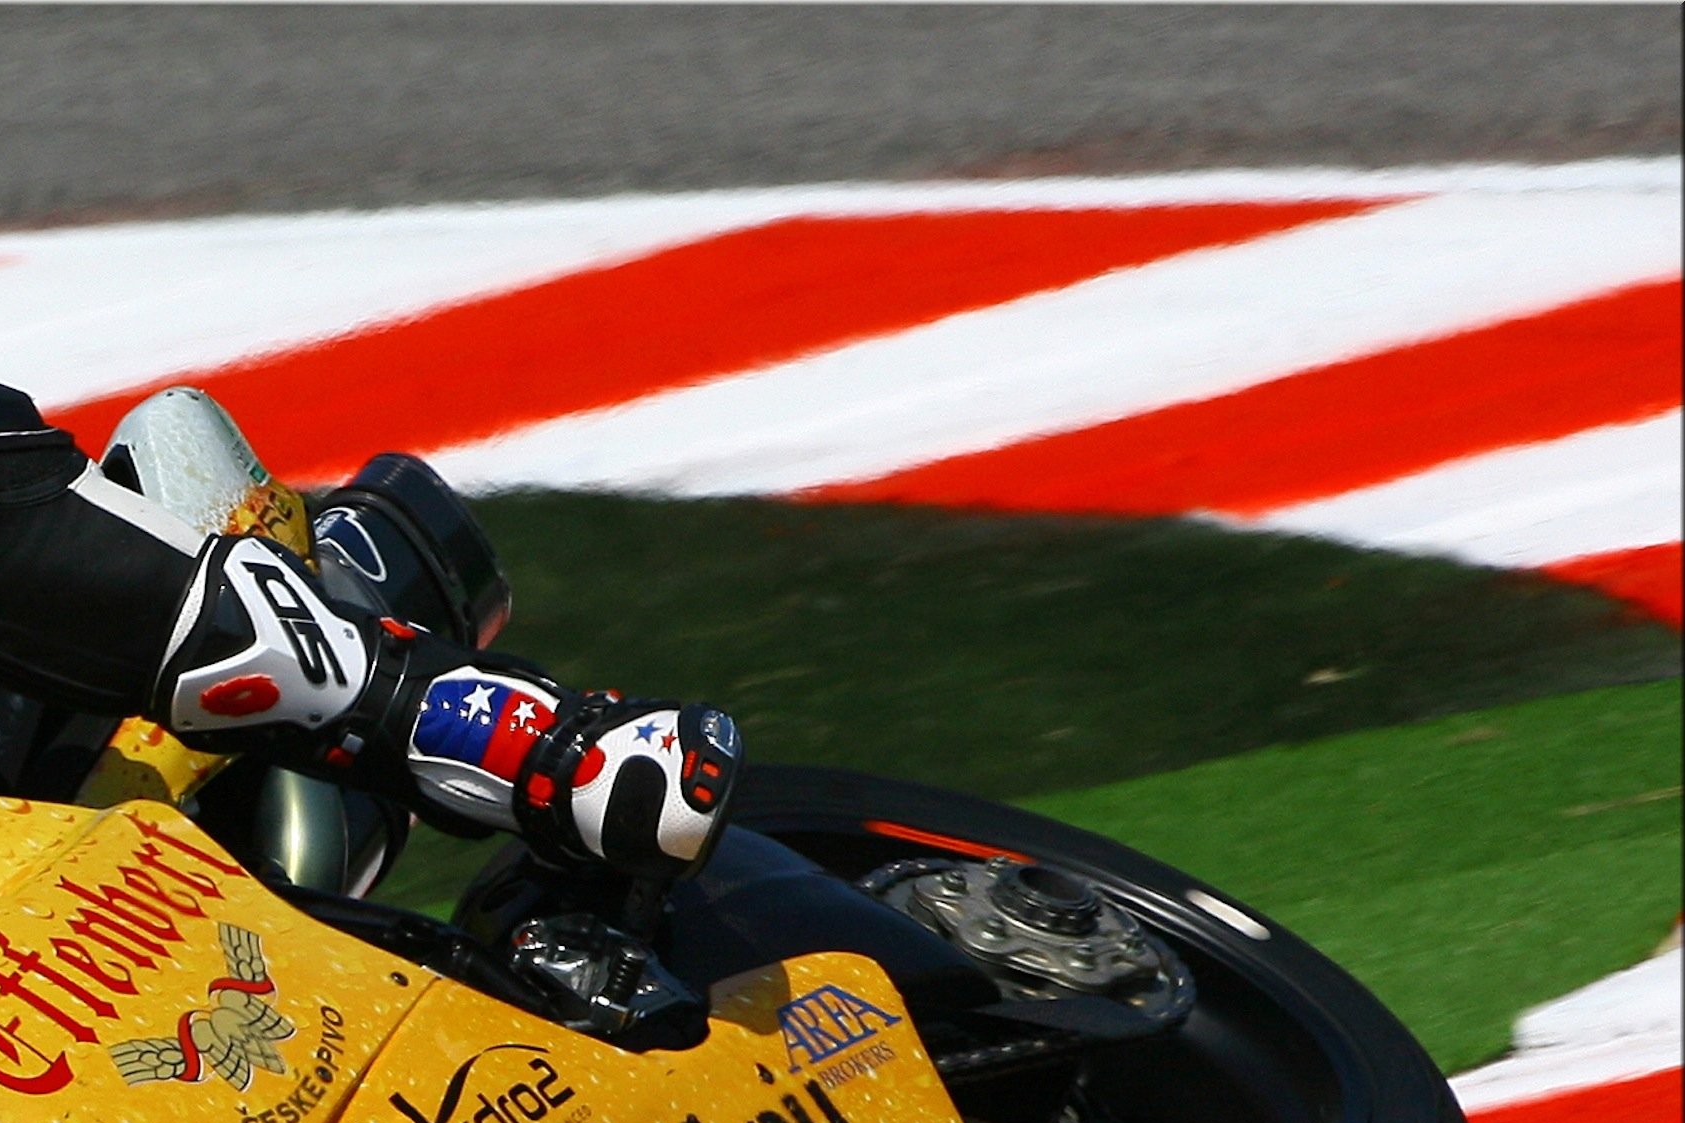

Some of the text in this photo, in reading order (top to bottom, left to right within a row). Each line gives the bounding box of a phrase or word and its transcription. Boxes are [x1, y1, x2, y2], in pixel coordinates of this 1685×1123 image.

[316, 1005, 345, 1069] PIVO
[776, 984, 903, 1074] AREA
[817, 1040, 897, 1090] BROKERS
